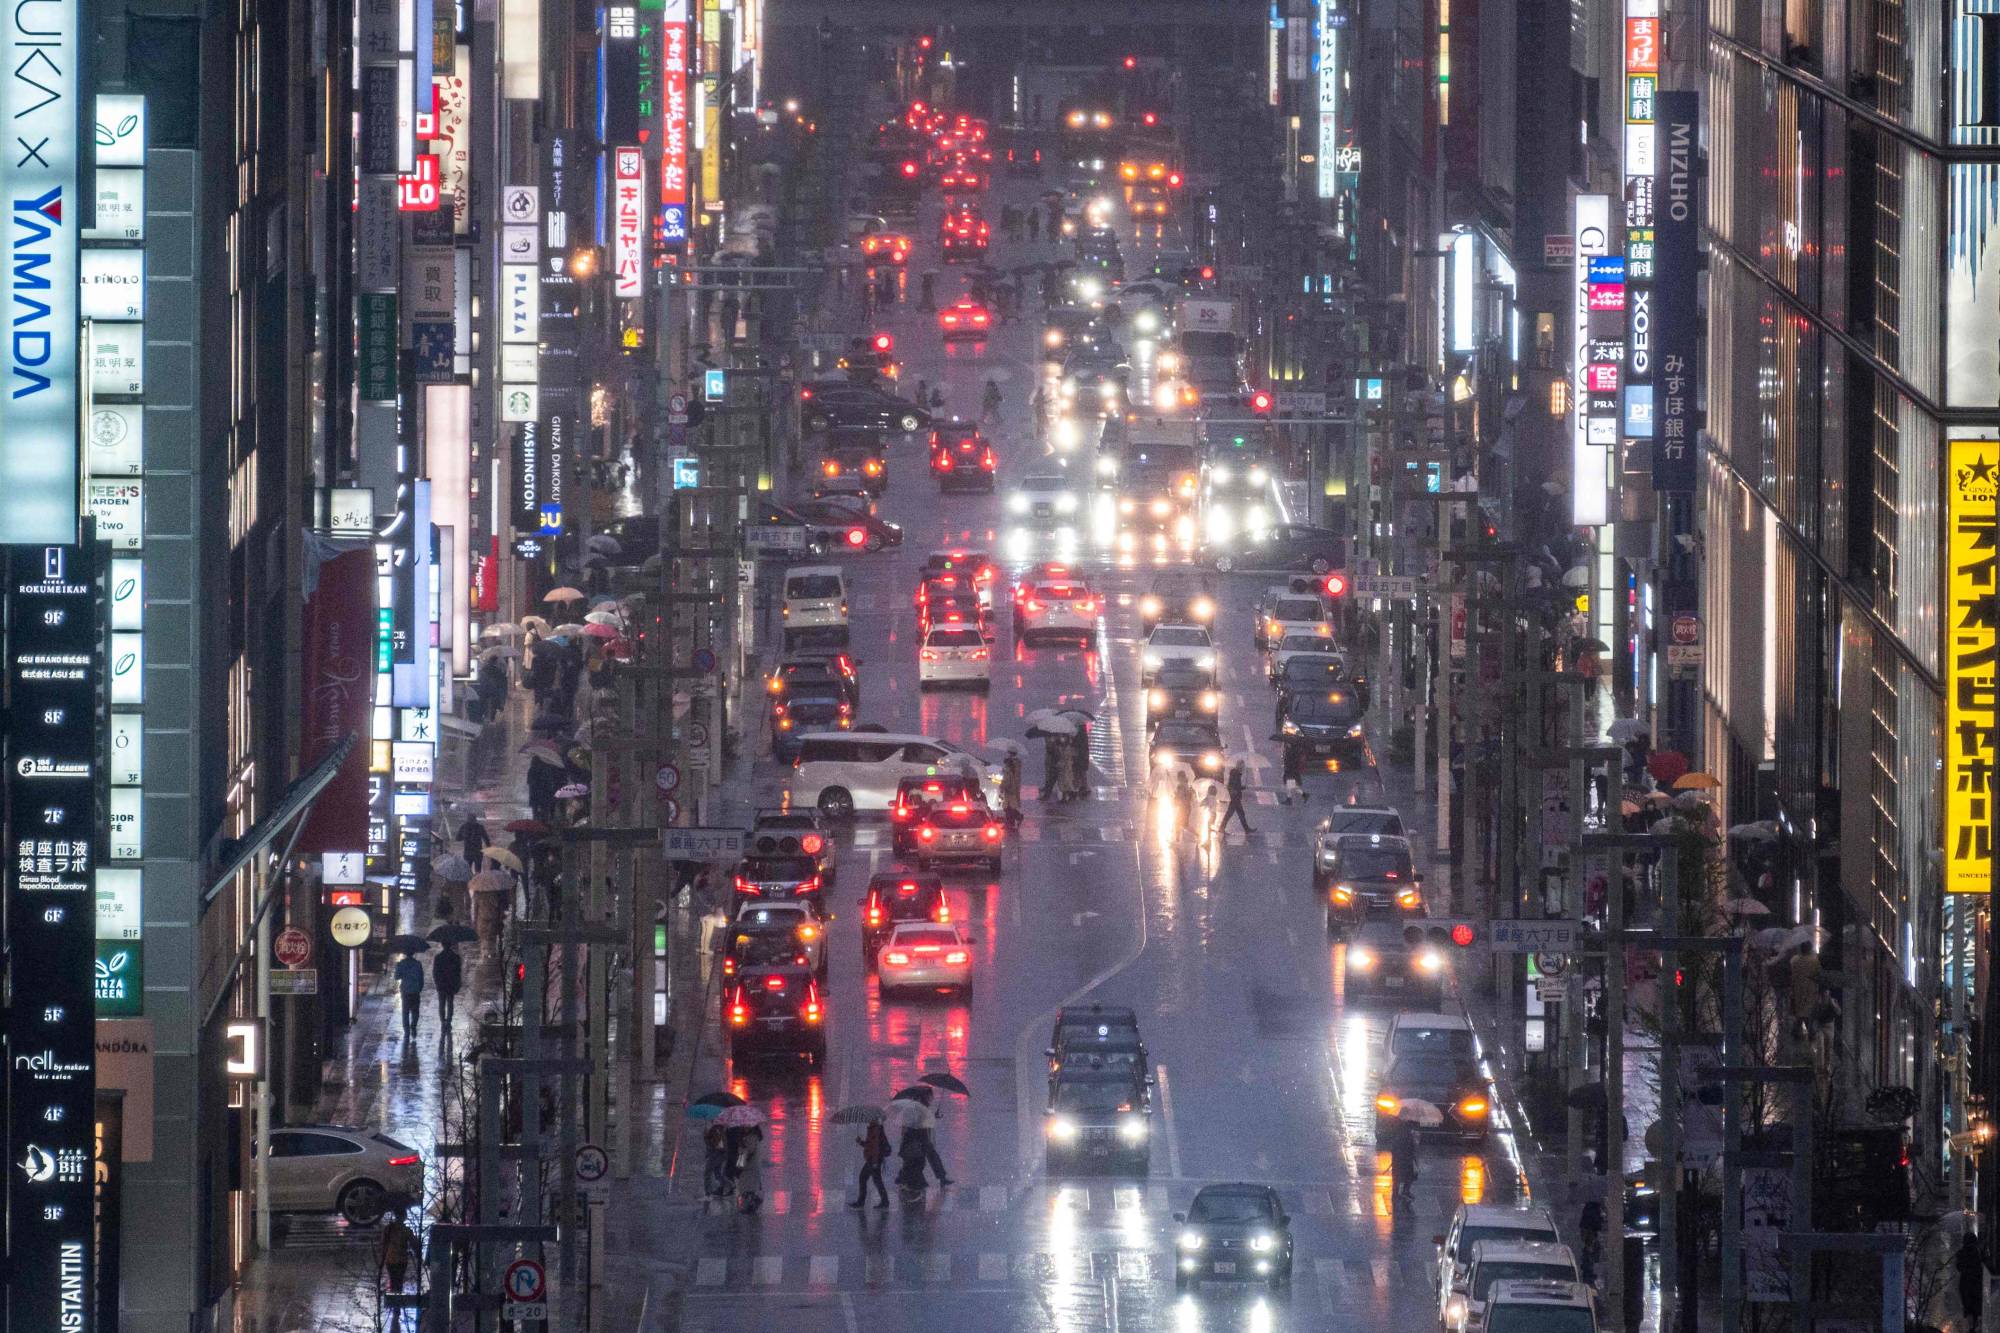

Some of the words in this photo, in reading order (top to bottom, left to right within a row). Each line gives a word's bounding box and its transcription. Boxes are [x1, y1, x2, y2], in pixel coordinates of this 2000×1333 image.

[1632, 78, 1652, 120] 歯科
[1670, 122, 1690, 221] MIZUHO
[125, 229, 139, 237] 10F
[620, 186, 640, 290] キムラヤのパン
[1631, 243, 1652, 277] 歯科
[13, 186, 62, 400] YAMADA
[514, 273, 527, 334] PLAZA
[127, 307, 139, 315] 9F
[1634, 291, 1648, 372] GEOX
[129, 384, 139, 392] 8F
[1665, 355, 1684, 459] みずほ銀行
[551, 416, 561, 450] GINZA
[129, 465, 138, 473] 7F
[524, 422, 535, 510] WASHINGTON
[128, 538, 139, 546] 6F
[19, 585, 87, 594] ROKUMEIKAN
[44, 611, 63, 624] 9F
[18, 655, 33, 664] ASU
[1956, 514, 1996, 861] ライオンビヤホール
[44, 711, 63, 724] 8F
[128, 774, 138, 782] 3F
[659, 773, 676, 786] 50
[44, 810, 63, 823] 7F
[19, 842, 88, 857] 銀座血液
[670, 836, 739, 850] 銀座六丁目
[19, 858, 86, 873] 検査ラボ
[41, 875, 60, 883] Blood
[44, 910, 62, 923] 6F
[1496, 928, 1570, 943] 銀座六丁目
[44, 1009, 63, 1022] 5F
[16, 1051, 52, 1070] nell
[44, 1108, 62, 1121] 4F
[58, 1161, 83, 1174] Bit
[44, 1207, 62, 1220] 3F
